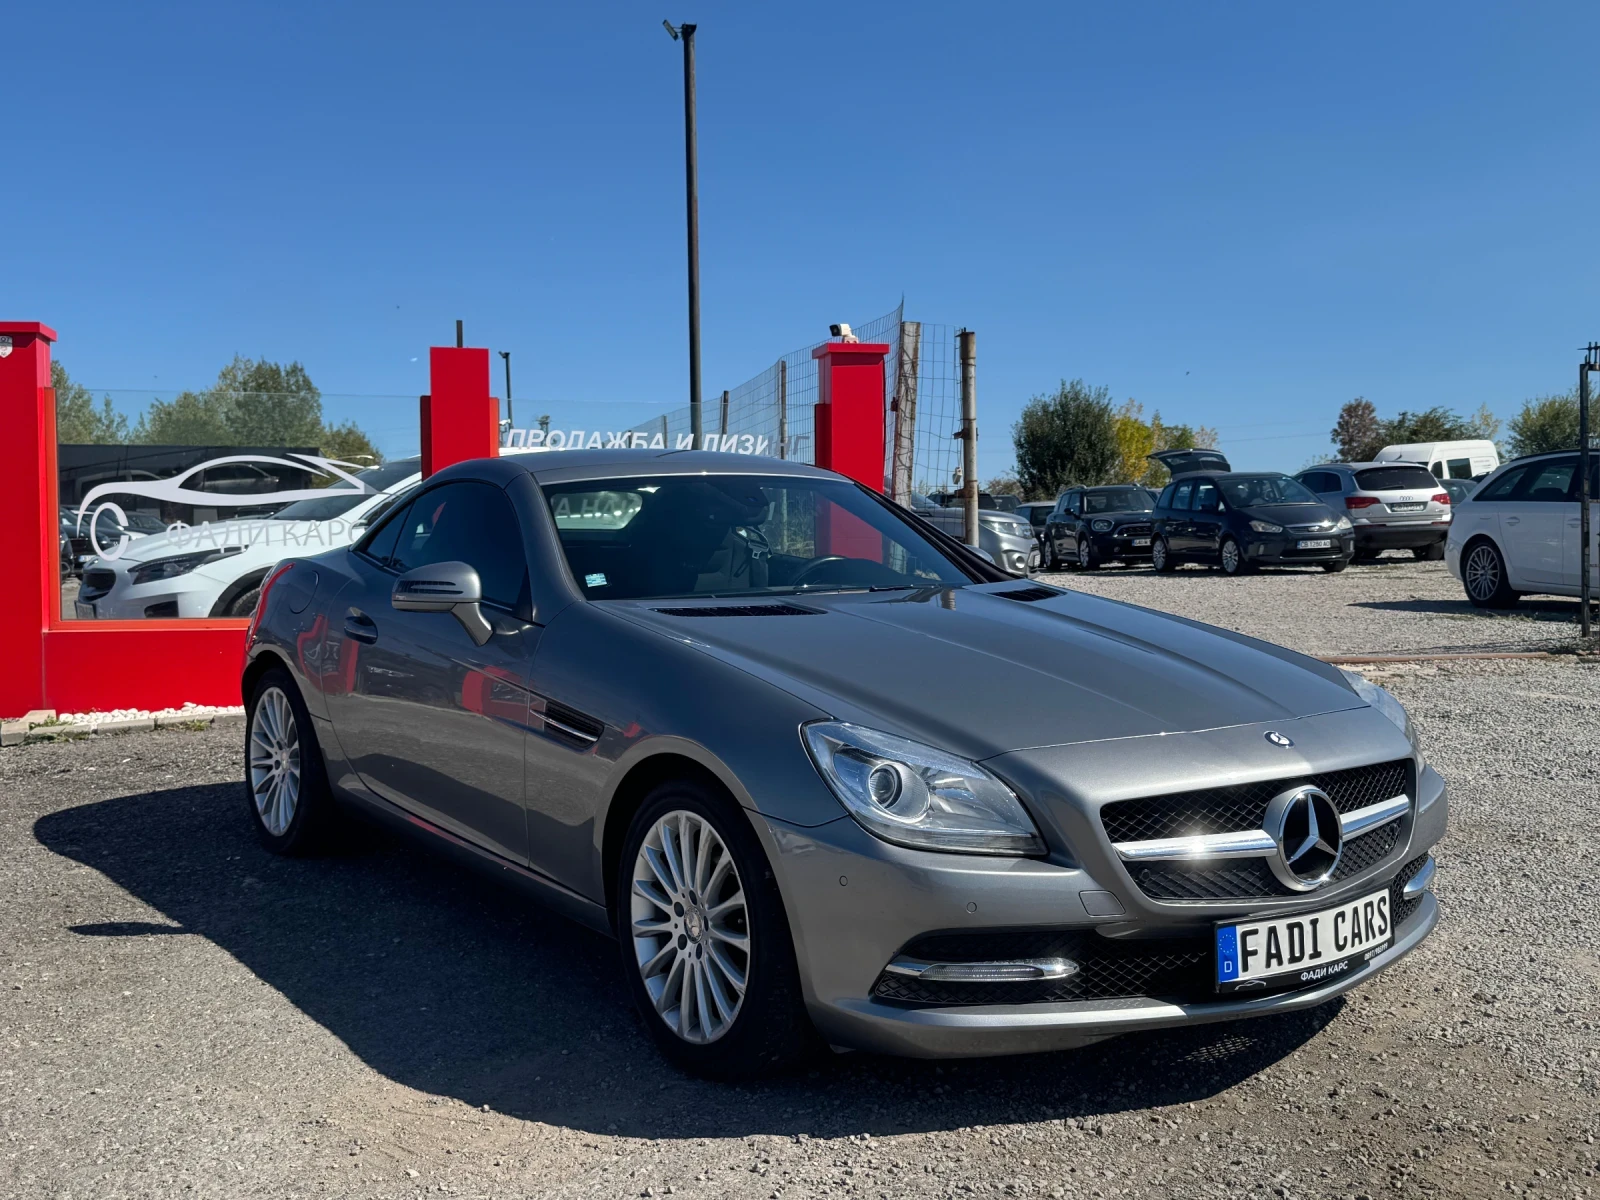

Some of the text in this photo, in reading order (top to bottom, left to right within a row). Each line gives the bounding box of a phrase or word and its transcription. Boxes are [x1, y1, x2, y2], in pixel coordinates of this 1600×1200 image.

[166, 520, 270, 553] ФАДИ
[1240, 895, 1388, 973] FADI CARS
[1224, 960, 1233, 973] D
[1300, 960, 1349, 982] ФАДИ КАРС
